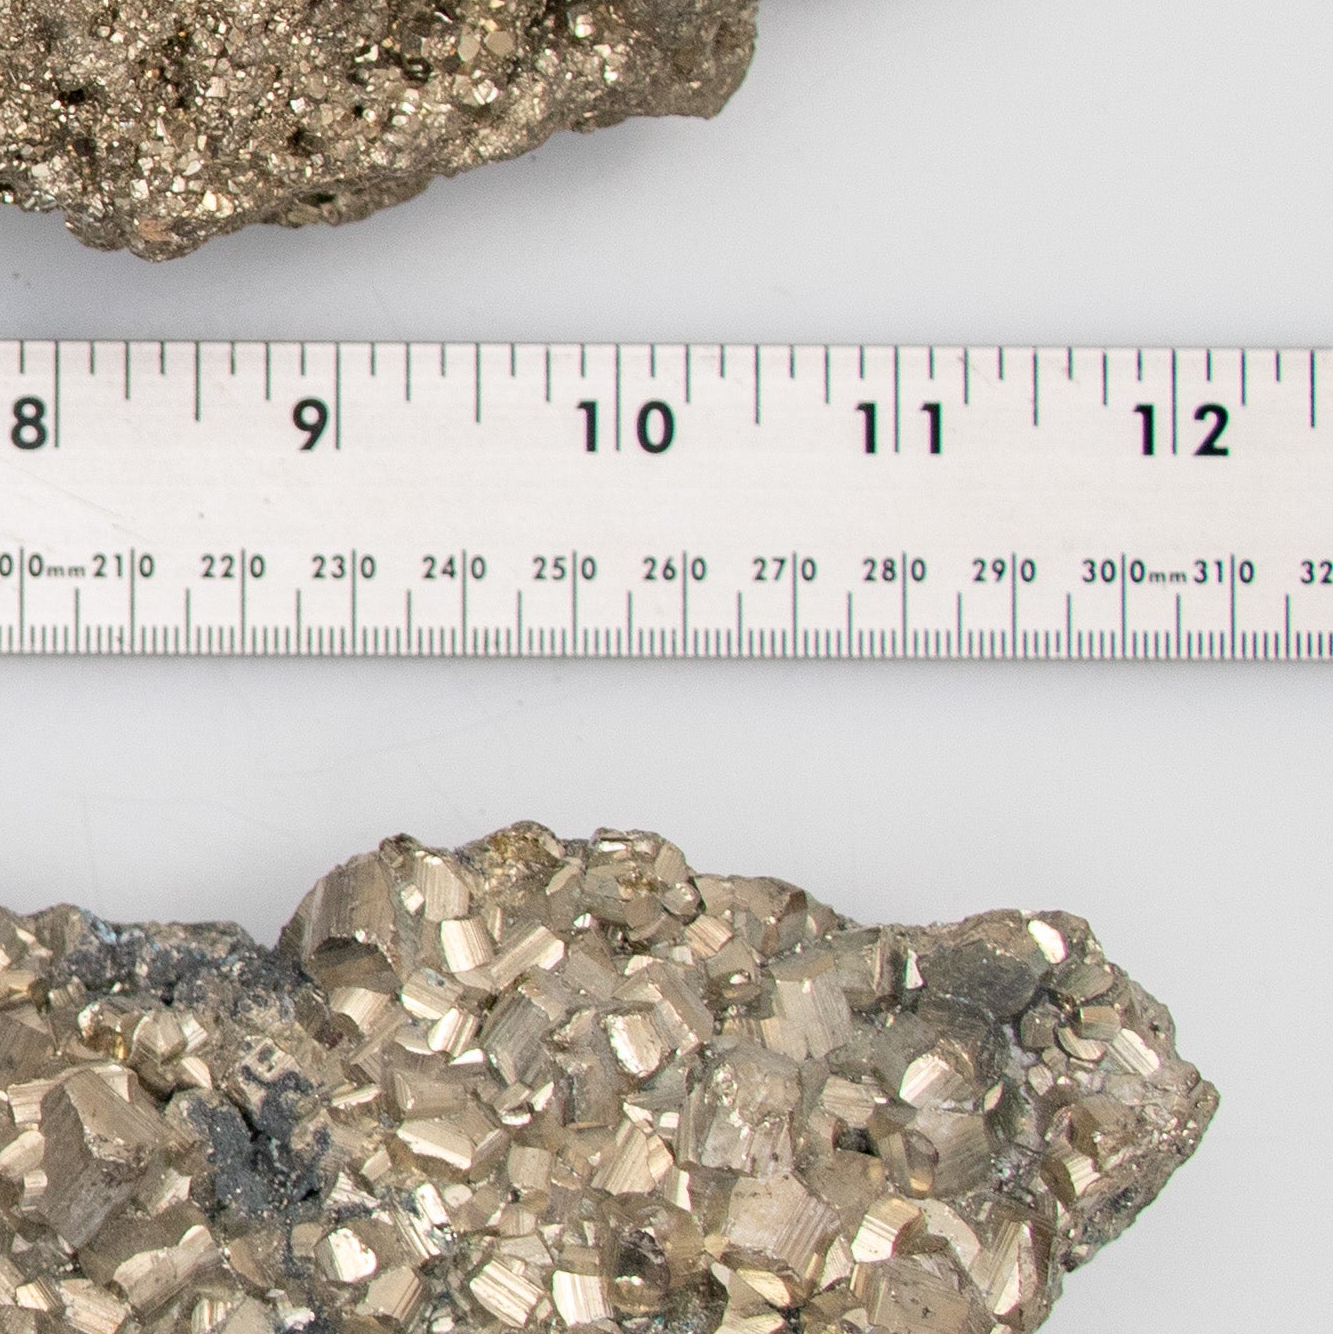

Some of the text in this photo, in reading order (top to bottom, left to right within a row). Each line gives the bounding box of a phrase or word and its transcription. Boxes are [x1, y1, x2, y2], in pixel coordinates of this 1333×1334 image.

[10, 396, 48, 451] 8
[292, 398, 329, 451] 9
[576, 398, 675, 455] 10
[856, 399, 942, 455] 11
[1134, 401, 1229, 457] 12
[92, 554, 155, 580] 210
[201, 554, 266, 580] 220
[312, 555, 376, 581] 230
[422, 556, 487, 582] 240
[533, 556, 597, 582] 250
[643, 557, 707, 583] 260
[753, 557, 817, 583] 270
[863, 558, 927, 584] 280
[972, 559, 1036, 585] 290
[1193, 560, 1255, 586] 310
